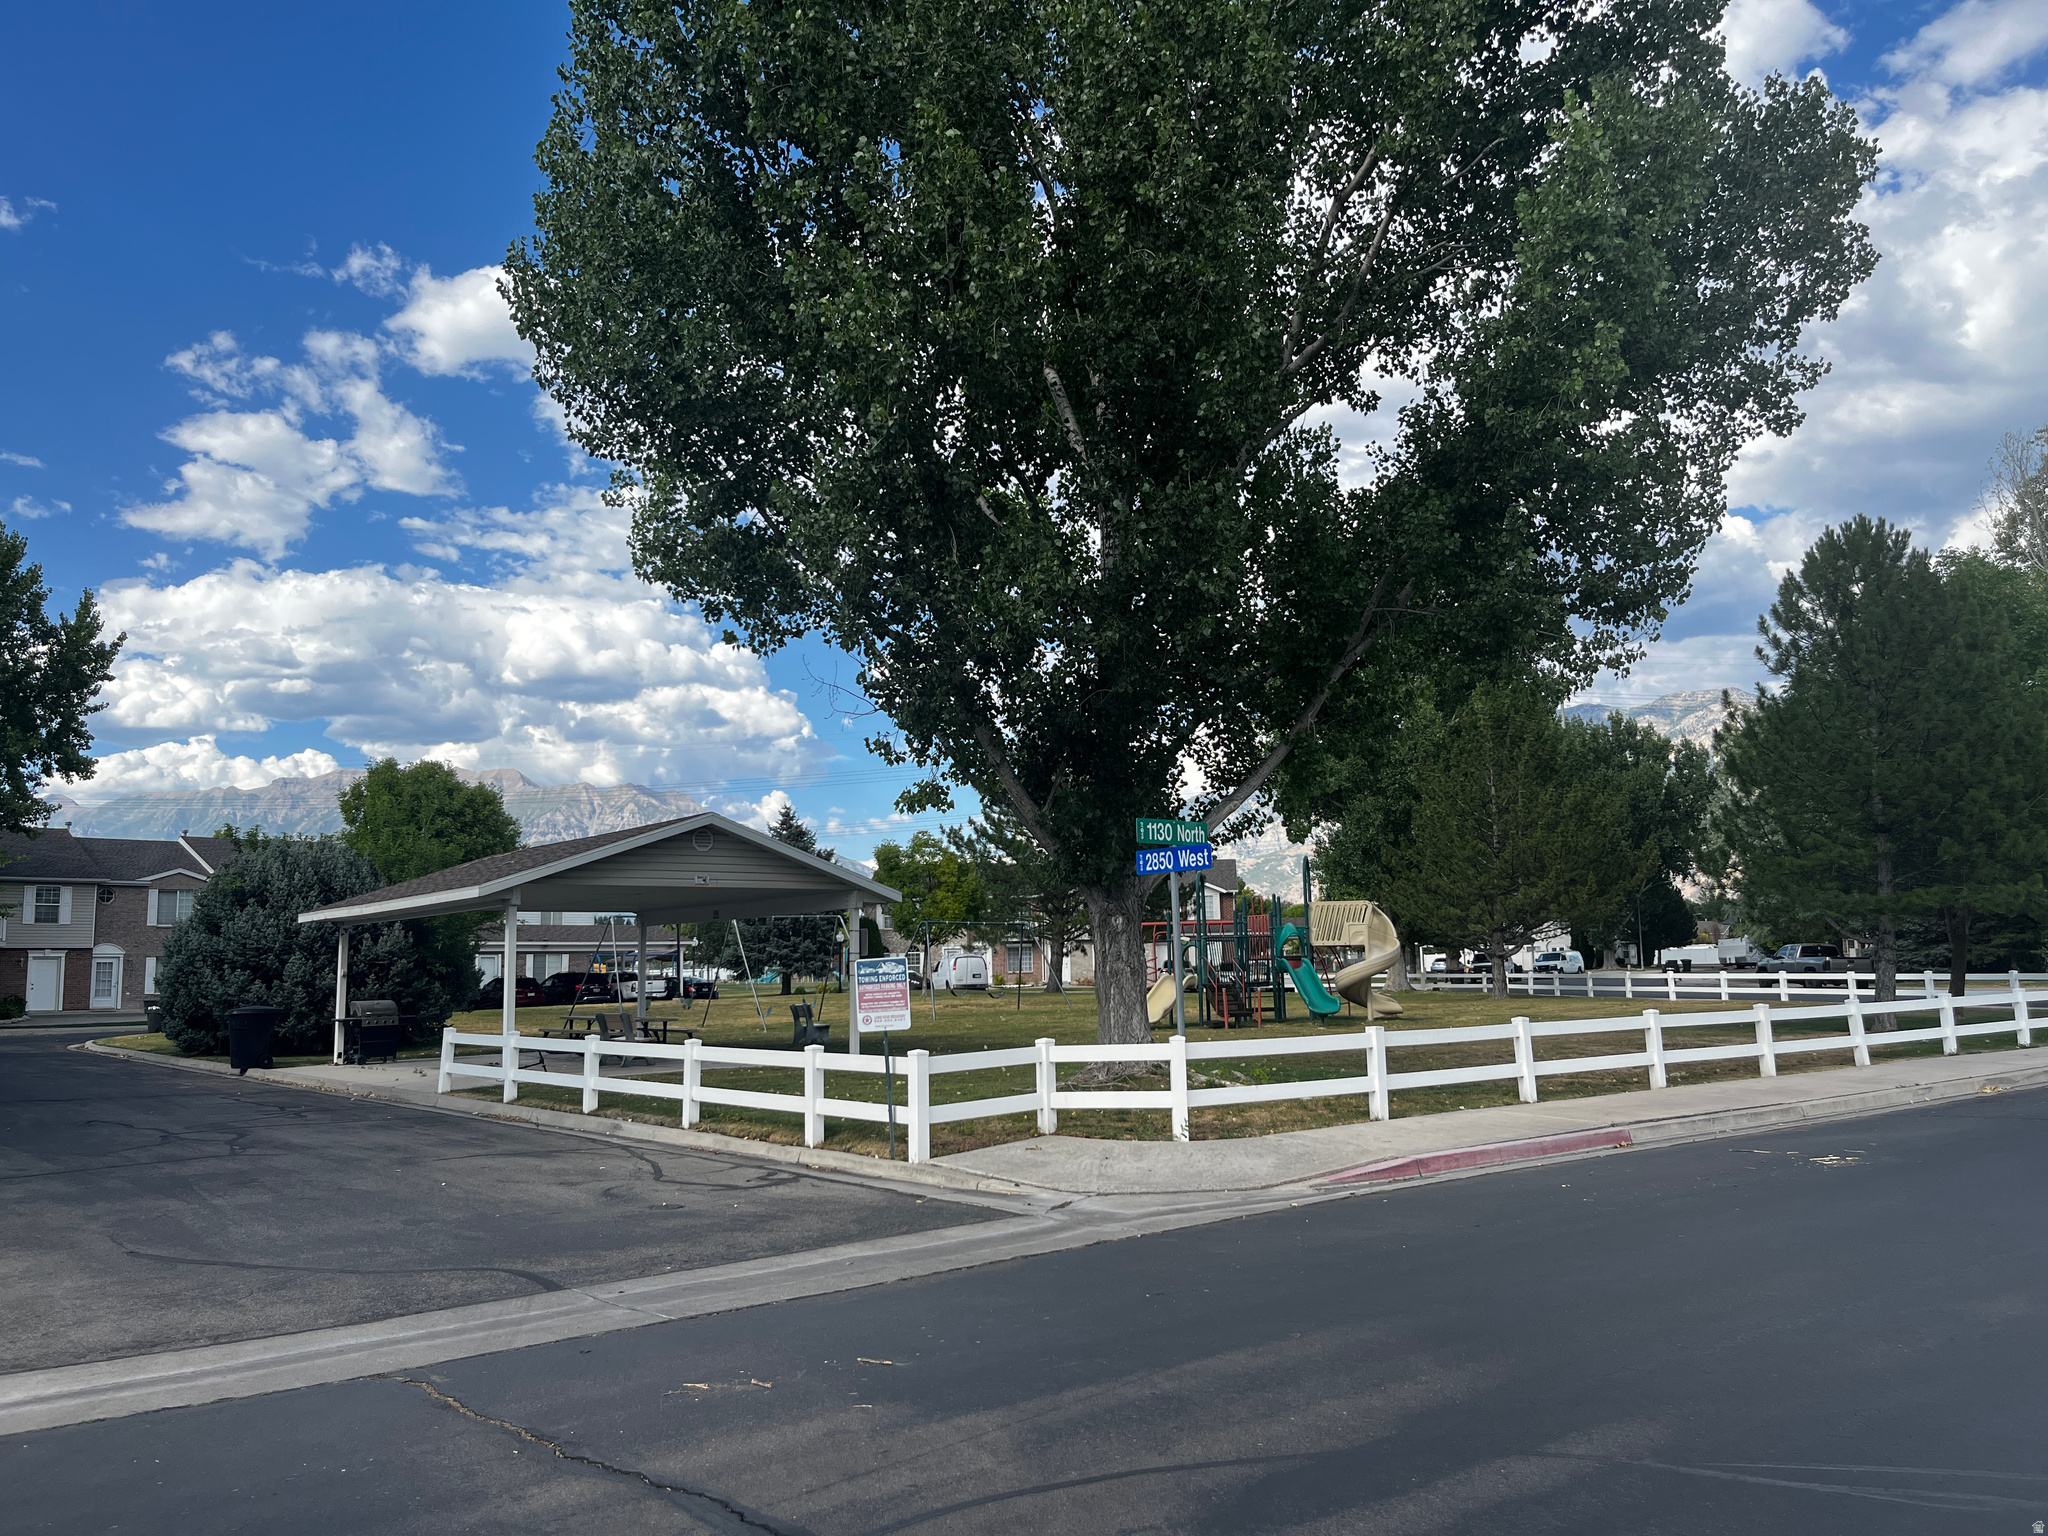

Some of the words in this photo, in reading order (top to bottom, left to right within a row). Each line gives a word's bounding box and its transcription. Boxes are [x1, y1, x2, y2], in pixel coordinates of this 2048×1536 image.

[1147, 822, 1173, 841] 1130
[1177, 824, 1205, 843] North
[1145, 851, 1174, 871] 2850
[1178, 848, 1209, 867] West
[879, 974, 905, 982] ENFORCED
